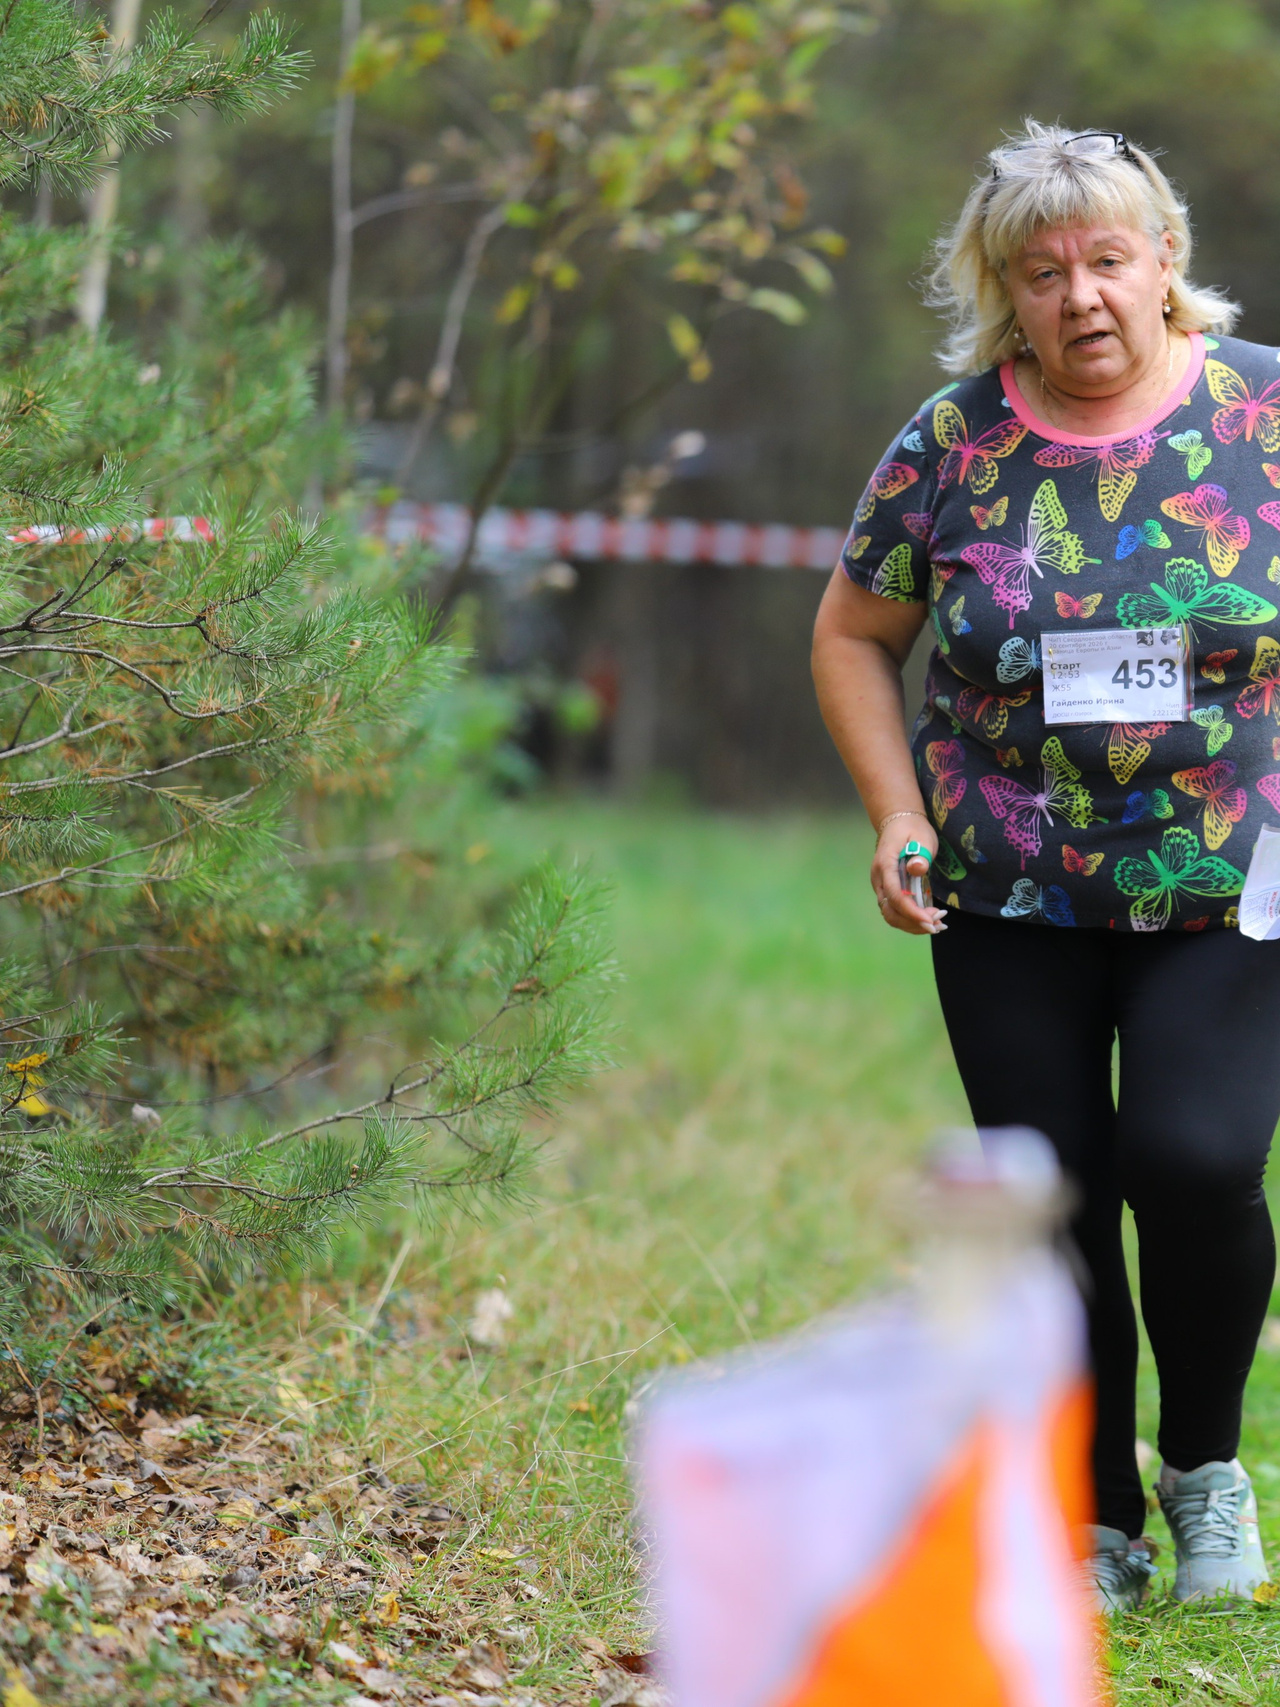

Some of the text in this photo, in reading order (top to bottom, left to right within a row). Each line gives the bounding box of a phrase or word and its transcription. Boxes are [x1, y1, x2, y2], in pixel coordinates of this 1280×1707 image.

[1050, 662, 1081, 670] Старт
[1051, 670, 1080, 679] 12:53
[1112, 658, 1178, 690] 453
[1052, 684, 1072, 692] Ж55
[1051, 698, 1125, 707] Гайденко Ирина
